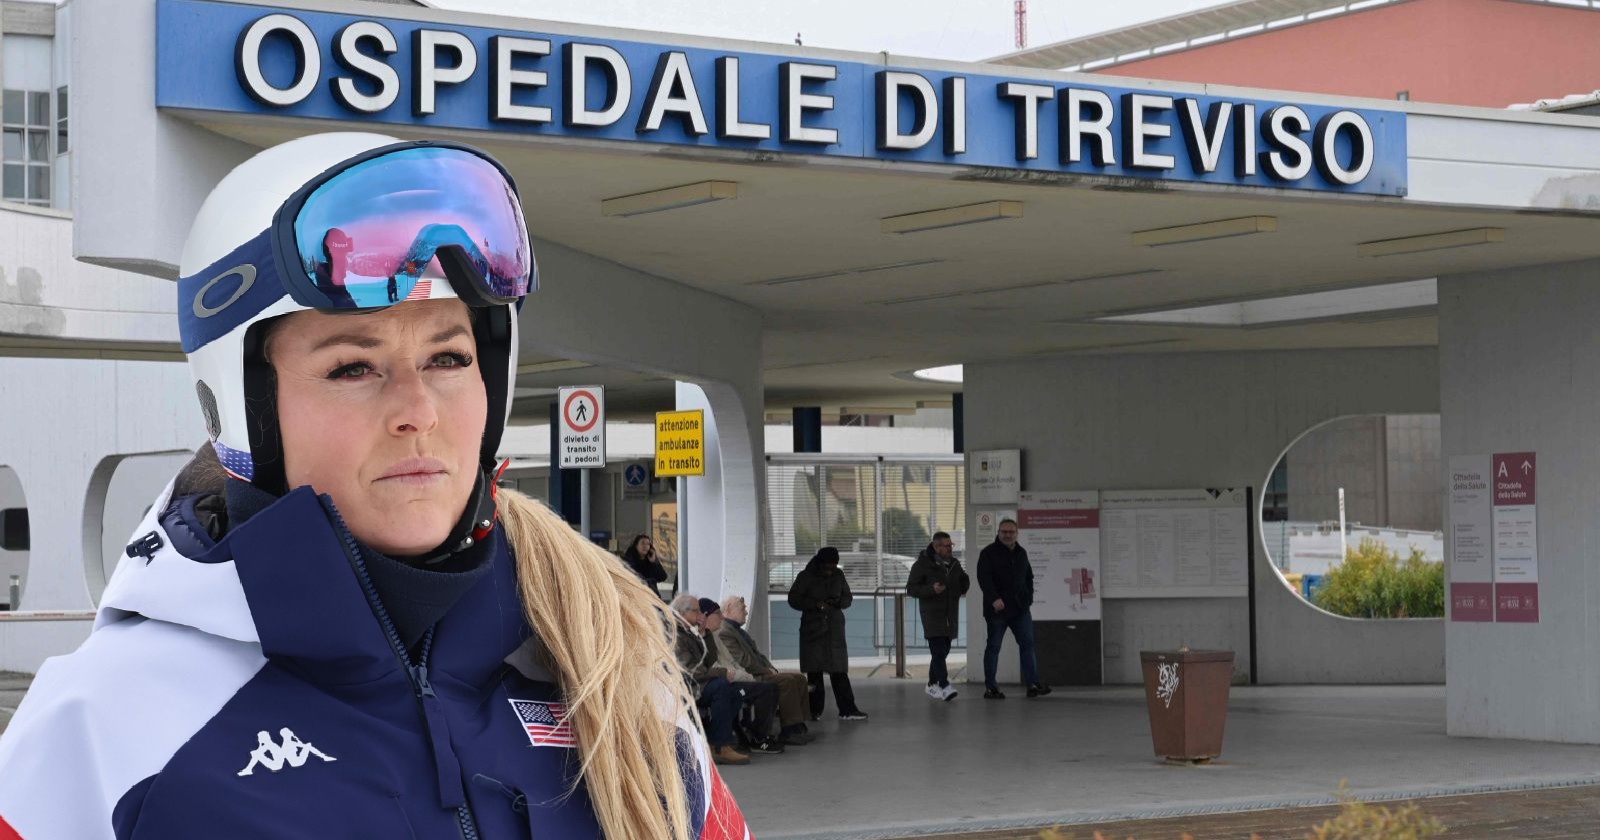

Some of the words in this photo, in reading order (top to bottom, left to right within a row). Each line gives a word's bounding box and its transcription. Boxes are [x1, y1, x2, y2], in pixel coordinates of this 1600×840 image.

[234, 13, 839, 145] OSPEDALE
[874, 69, 967, 155] DI
[996, 81, 1376, 187] TREVISO
[659, 418, 699, 432] attenzione
[563, 435, 589, 444] divieto
[592, 435, 600, 443] di
[659, 437, 700, 451] ambulanze
[567, 445, 597, 453] transito
[564, 455, 572, 463] ai
[574, 455, 600, 465] pedoni
[658, 458, 665, 470] in
[669, 456, 701, 469] transito
[1498, 461, 1508, 478] A
[1453, 472, 1481, 482] Cittadella
[1453, 482, 1468, 491] della
[1469, 480, 1487, 490] Salute
[1498, 481, 1522, 491] Cittadella
[1498, 491, 1511, 500] della
[1511, 489, 1527, 499] Salute
